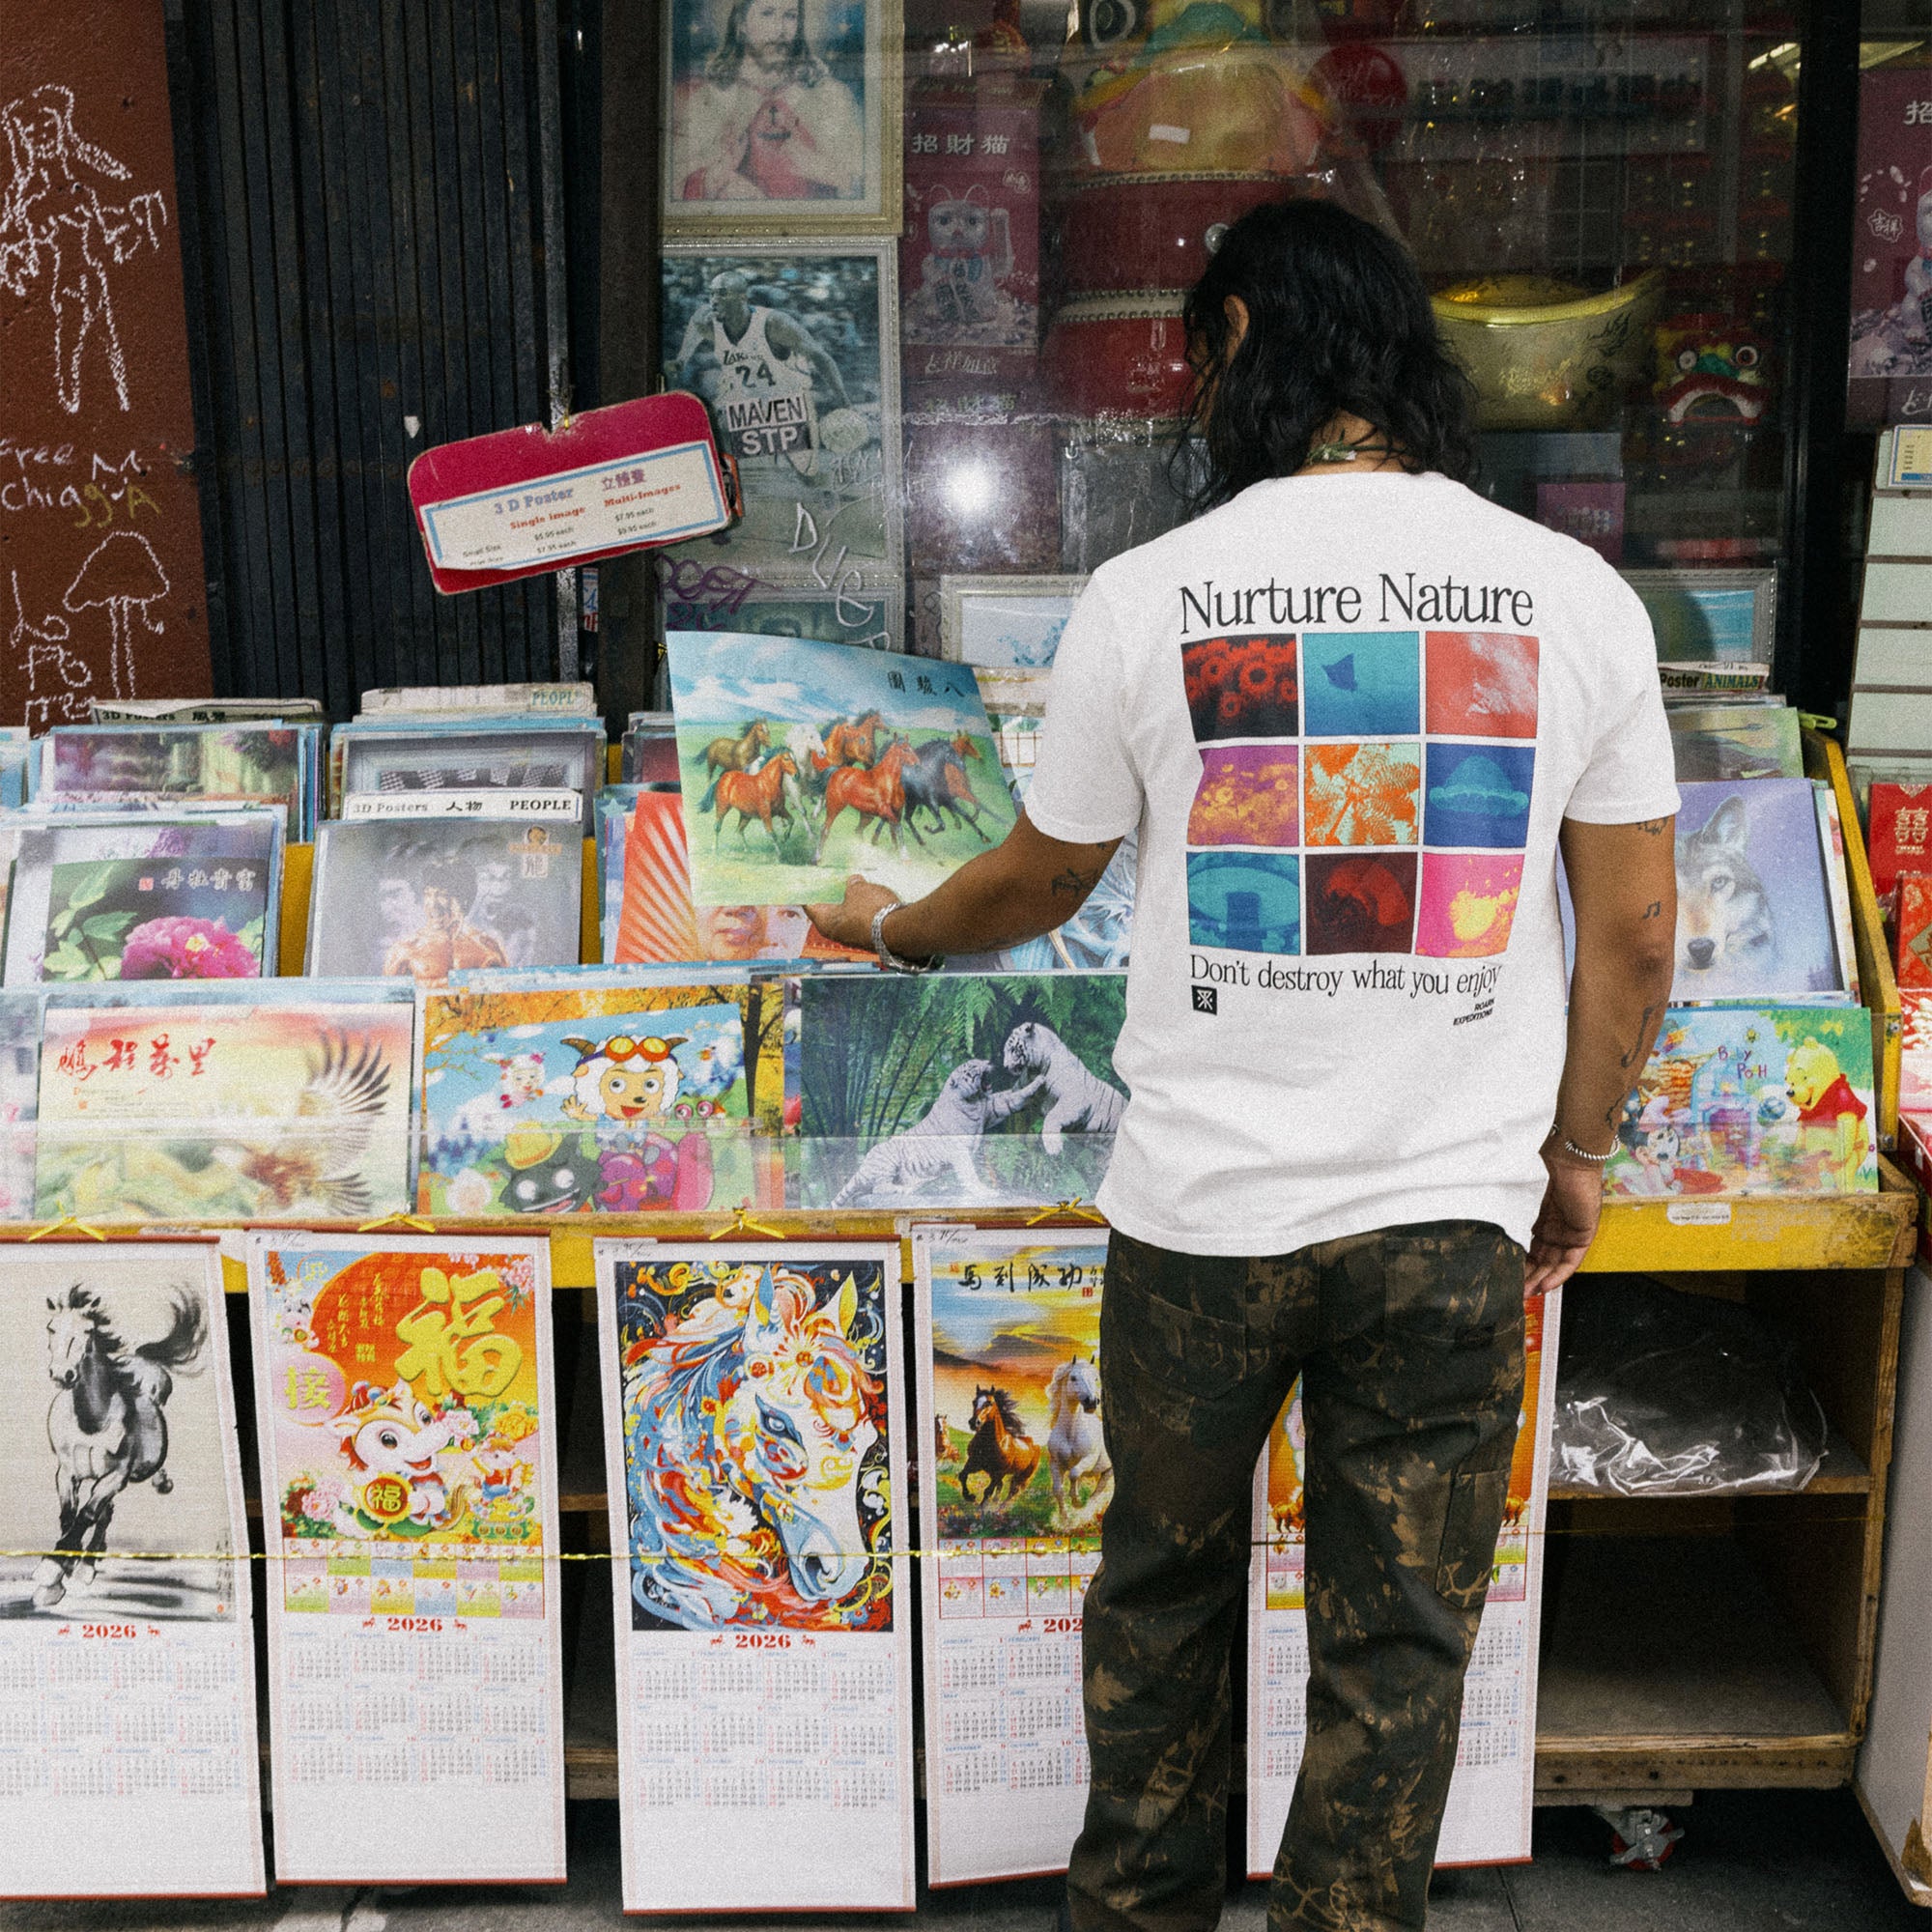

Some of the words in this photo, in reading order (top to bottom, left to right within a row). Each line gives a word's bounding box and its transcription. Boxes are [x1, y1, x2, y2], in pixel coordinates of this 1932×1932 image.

[735, 362, 777, 388] 24
[727, 396, 804, 428] MAVEN
[741, 425, 798, 455] STP
[524, 487, 574, 509] Poster
[604, 483, 682, 508] Multi-Images
[509, 516, 546, 530] Single
[1179, 577, 1362, 634] Nurture
[1378, 573, 1533, 627] Nature
[1705, 673, 1759, 690] ANIMALS
[102, 710, 122, 722] 3D
[354, 803, 373, 814] 3D
[376, 802, 429, 813] Posters
[445, 801, 483, 813] 人物
[509, 799, 572, 811] PEOPLE
[1190, 954, 1251, 987] Don't
[1258, 960, 1345, 997] destroy
[1350, 959, 1406, 990] what
[1410, 971, 1449, 999] you
[1456, 964, 1502, 998] enjoy
[394, 1266, 524, 1398] 福
[283, 1365, 331, 1410] 接
[371, 1483, 402, 1513] 福
[82, 1624, 137, 1639] 2026
[386, 1617, 443, 1633] 2026
[1043, 1617, 1083, 1634] 202
[735, 1634, 791, 1649] 2026
